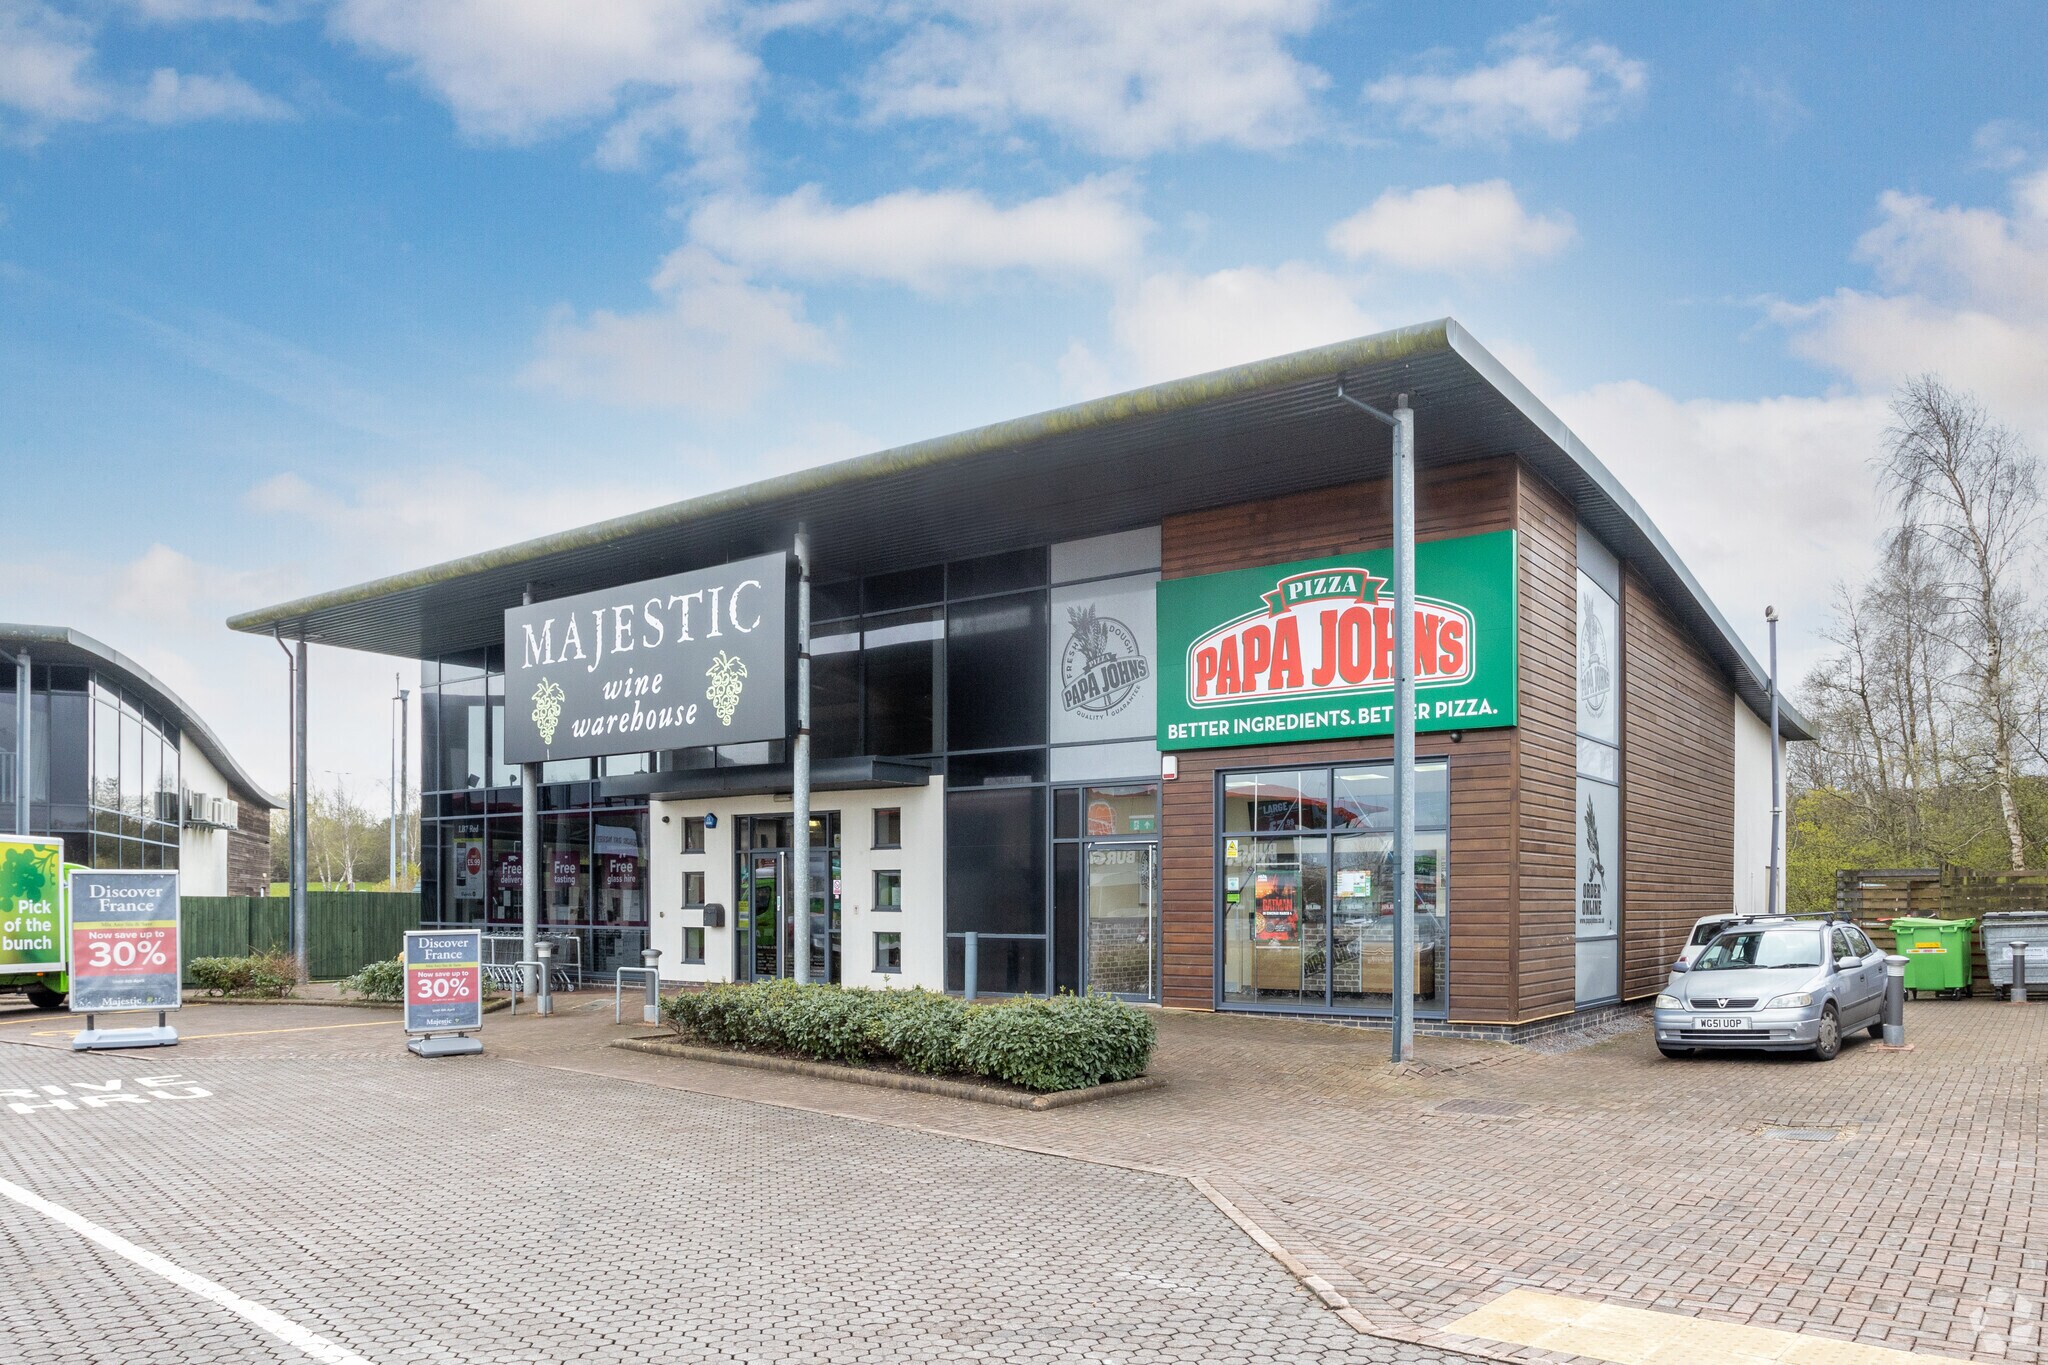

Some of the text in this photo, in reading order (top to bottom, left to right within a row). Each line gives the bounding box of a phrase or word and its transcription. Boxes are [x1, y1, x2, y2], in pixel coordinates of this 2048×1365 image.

[1289, 575, 1357, 600] PIZZA
[521, 579, 762, 673] MAJESTIC
[1108, 625, 1134, 654] DOUGH
[1196, 606, 1464, 697] PAPA JOHN'S
[1066, 642, 1079, 680] FRESH
[602, 667, 663, 700] wine
[1064, 672, 1100, 708] PAPA
[1076, 685, 1141, 720] QUALITY GUARANTEE
[571, 700, 698, 739] warehouse
[1168, 698, 1498, 739] BETTER INGREDIENTS. BETR PIZZA.
[1262, 801, 1289, 815] LARGE
[469, 824, 479, 833] Red
[502, 862, 522, 874] Free
[554, 861, 576, 873] Free
[609, 860, 633, 873] Free
[500, 875, 523, 886] delivery
[554, 875, 576, 885] tasting
[607, 874, 636, 885] glass hire
[89, 884, 163, 898] Discover
[1583, 883, 1601, 899] ORDER
[18, 899, 52, 914] Pick
[99, 899, 154, 912] France
[1582, 900, 1602, 916] ONLINE
[4, 917, 52, 932] of the
[2, 935, 52, 950] bunch
[88, 931, 112, 940] Now
[140, 931, 153, 940] up
[155, 930, 165, 938] to
[418, 937, 469, 949] Discover
[88, 940, 167, 968] 30%
[424, 949, 462, 960] France
[417, 977, 470, 998] 30%
[102, 996, 142, 1007] Majestic
[426, 1018, 452, 1026] Majestic
[1700, 1019, 1742, 1028] WG51 UOP
